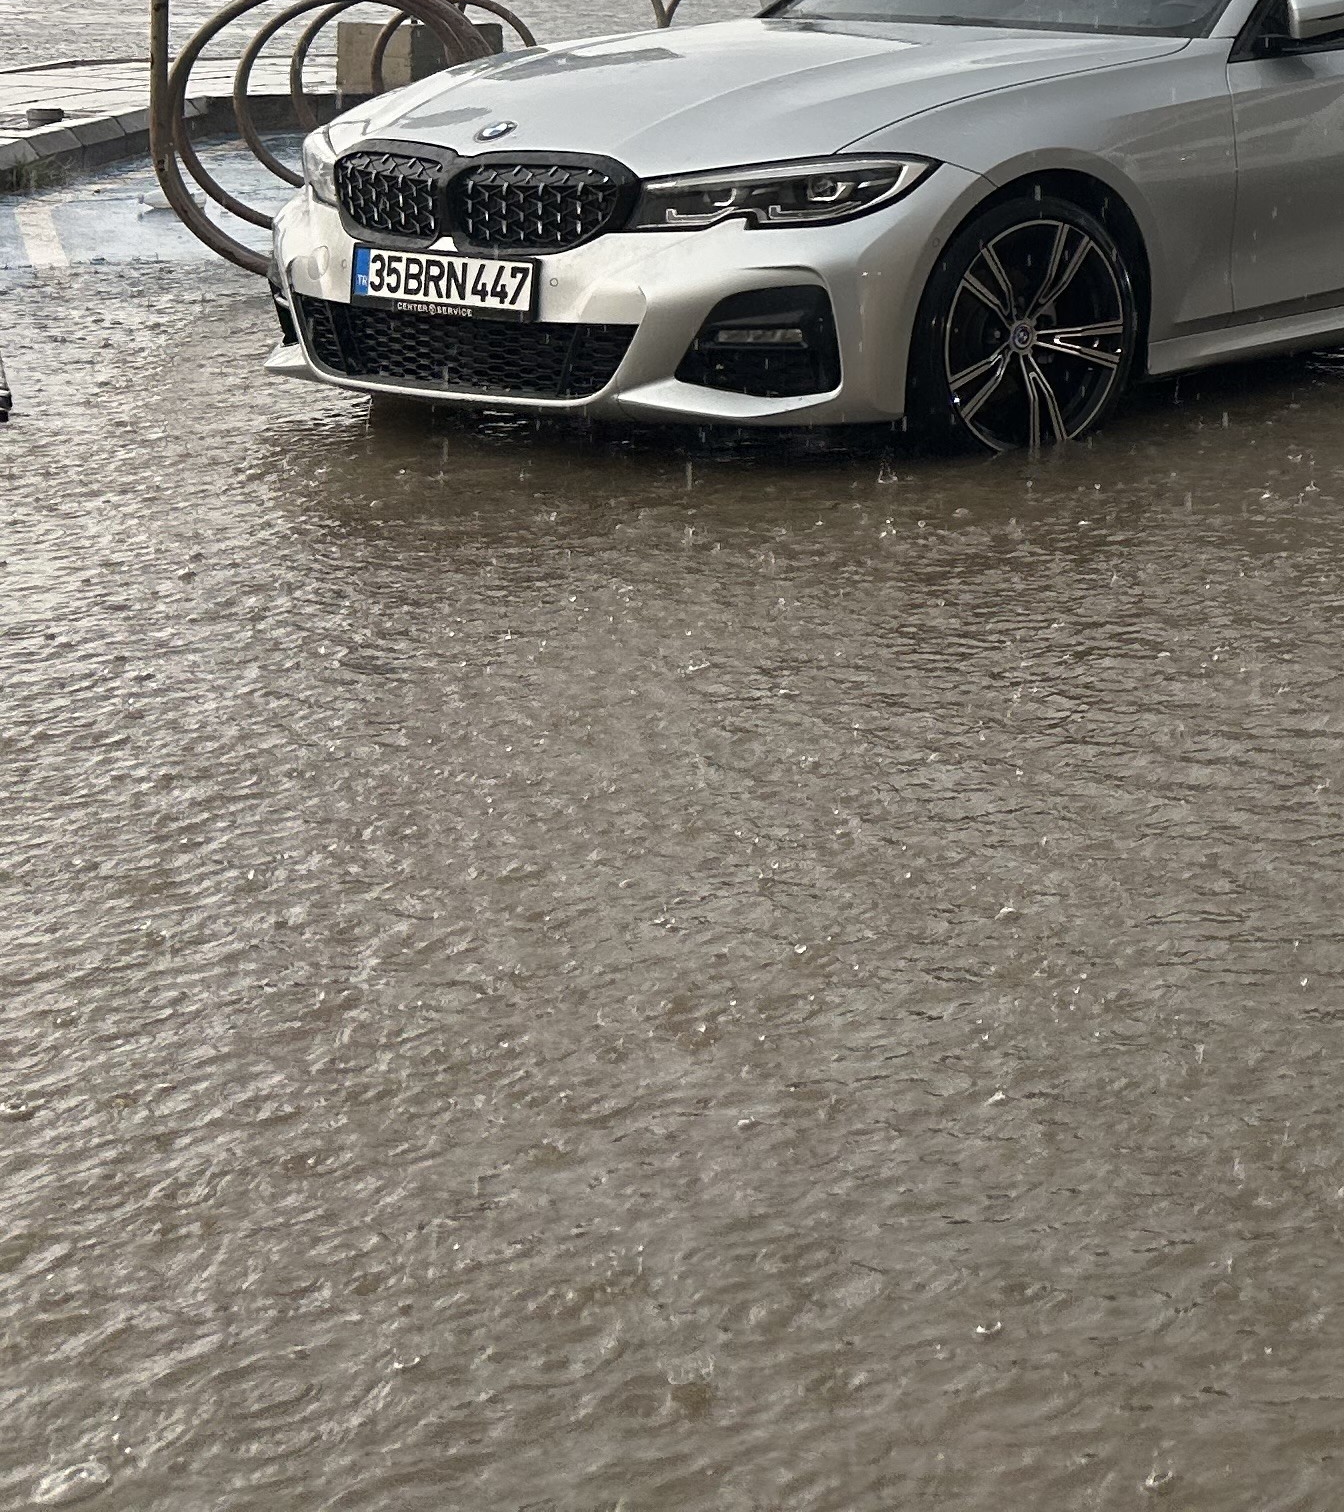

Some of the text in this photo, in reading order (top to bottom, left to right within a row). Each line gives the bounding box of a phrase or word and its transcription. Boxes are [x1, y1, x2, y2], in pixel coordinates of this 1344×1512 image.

[356, 253, 530, 305] TR 35BRN447
[397, 301, 428, 313] CENTER
